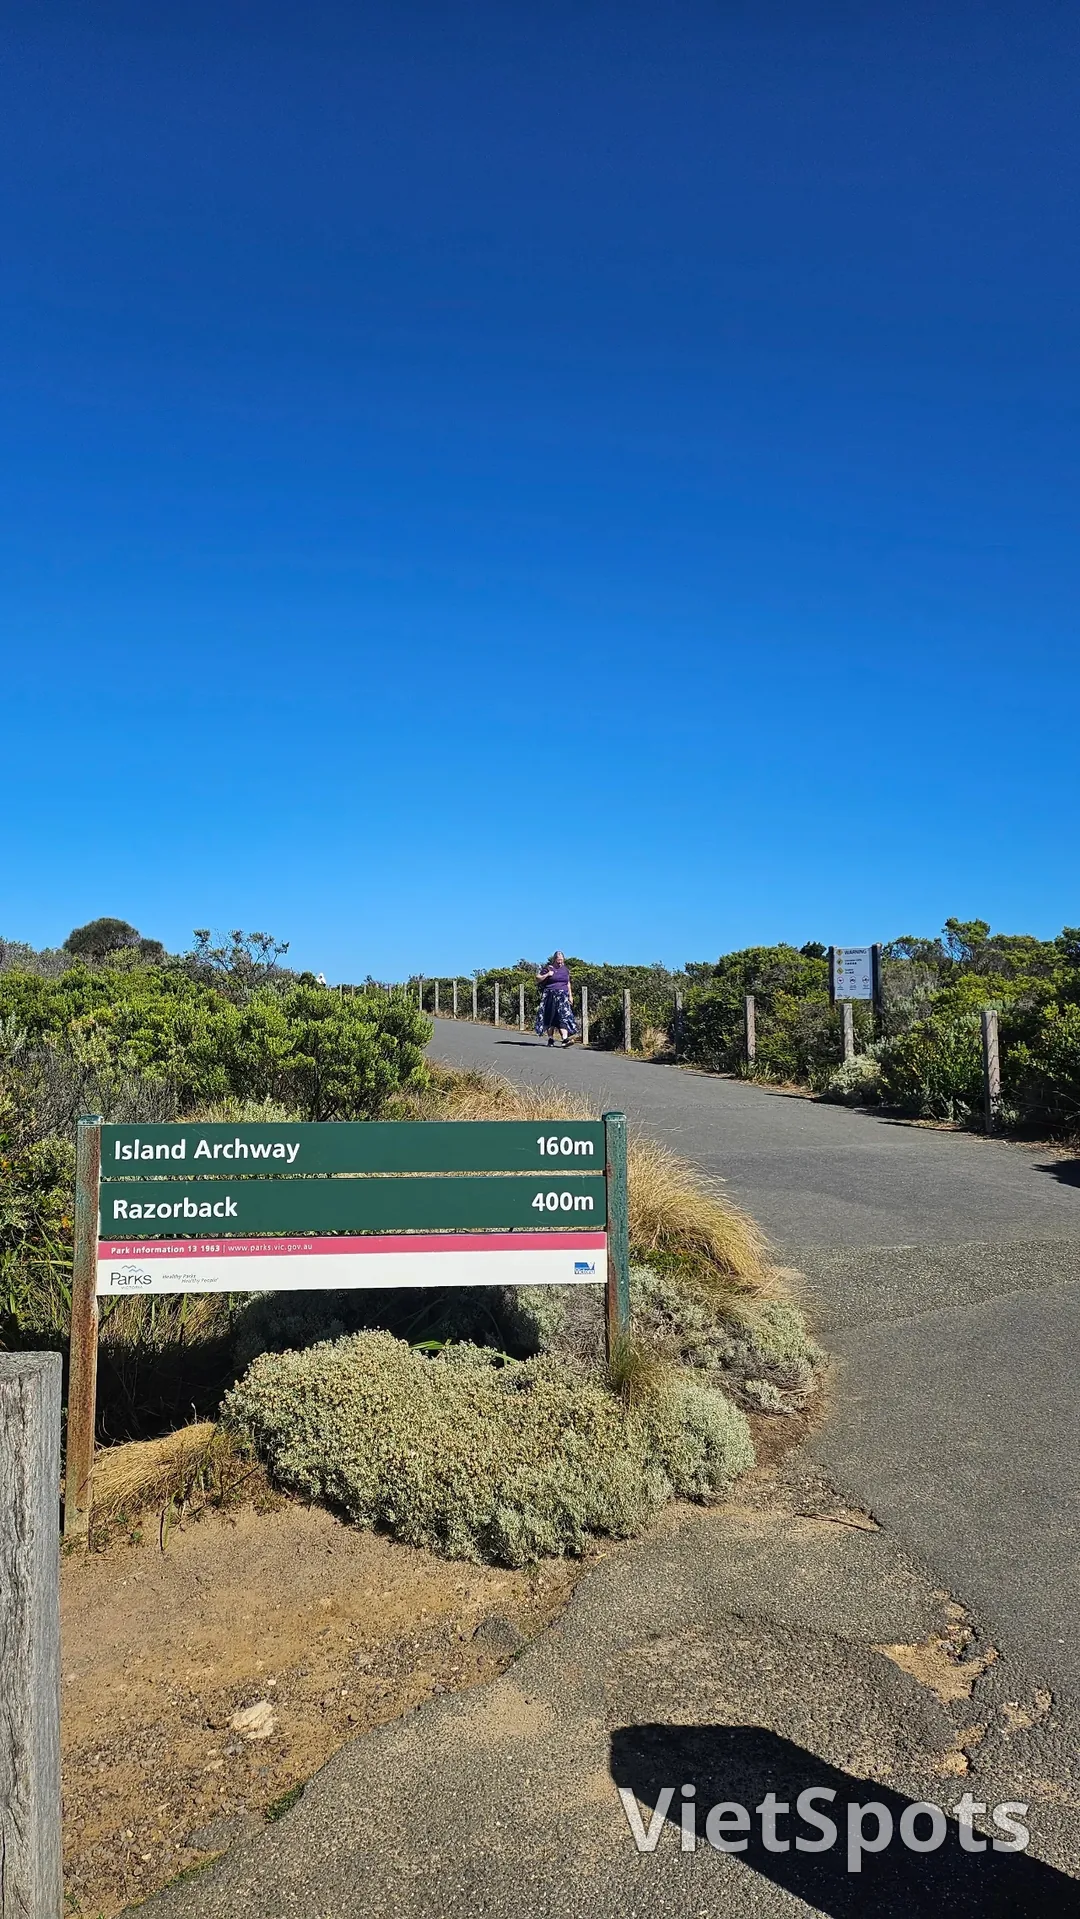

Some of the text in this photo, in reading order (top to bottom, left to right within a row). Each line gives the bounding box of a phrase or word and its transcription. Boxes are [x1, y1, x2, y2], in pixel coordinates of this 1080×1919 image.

[113, 1138, 301, 1163] Island Archway
[536, 1136, 595, 1157] 160m
[112, 1195, 239, 1220] Razorback
[531, 1192, 595, 1213] 400m
[110, 1243, 313, 1255] Park Information 13 1963 www.parks.vic.gov.au
[110, 1271, 152, 1286] Parks
